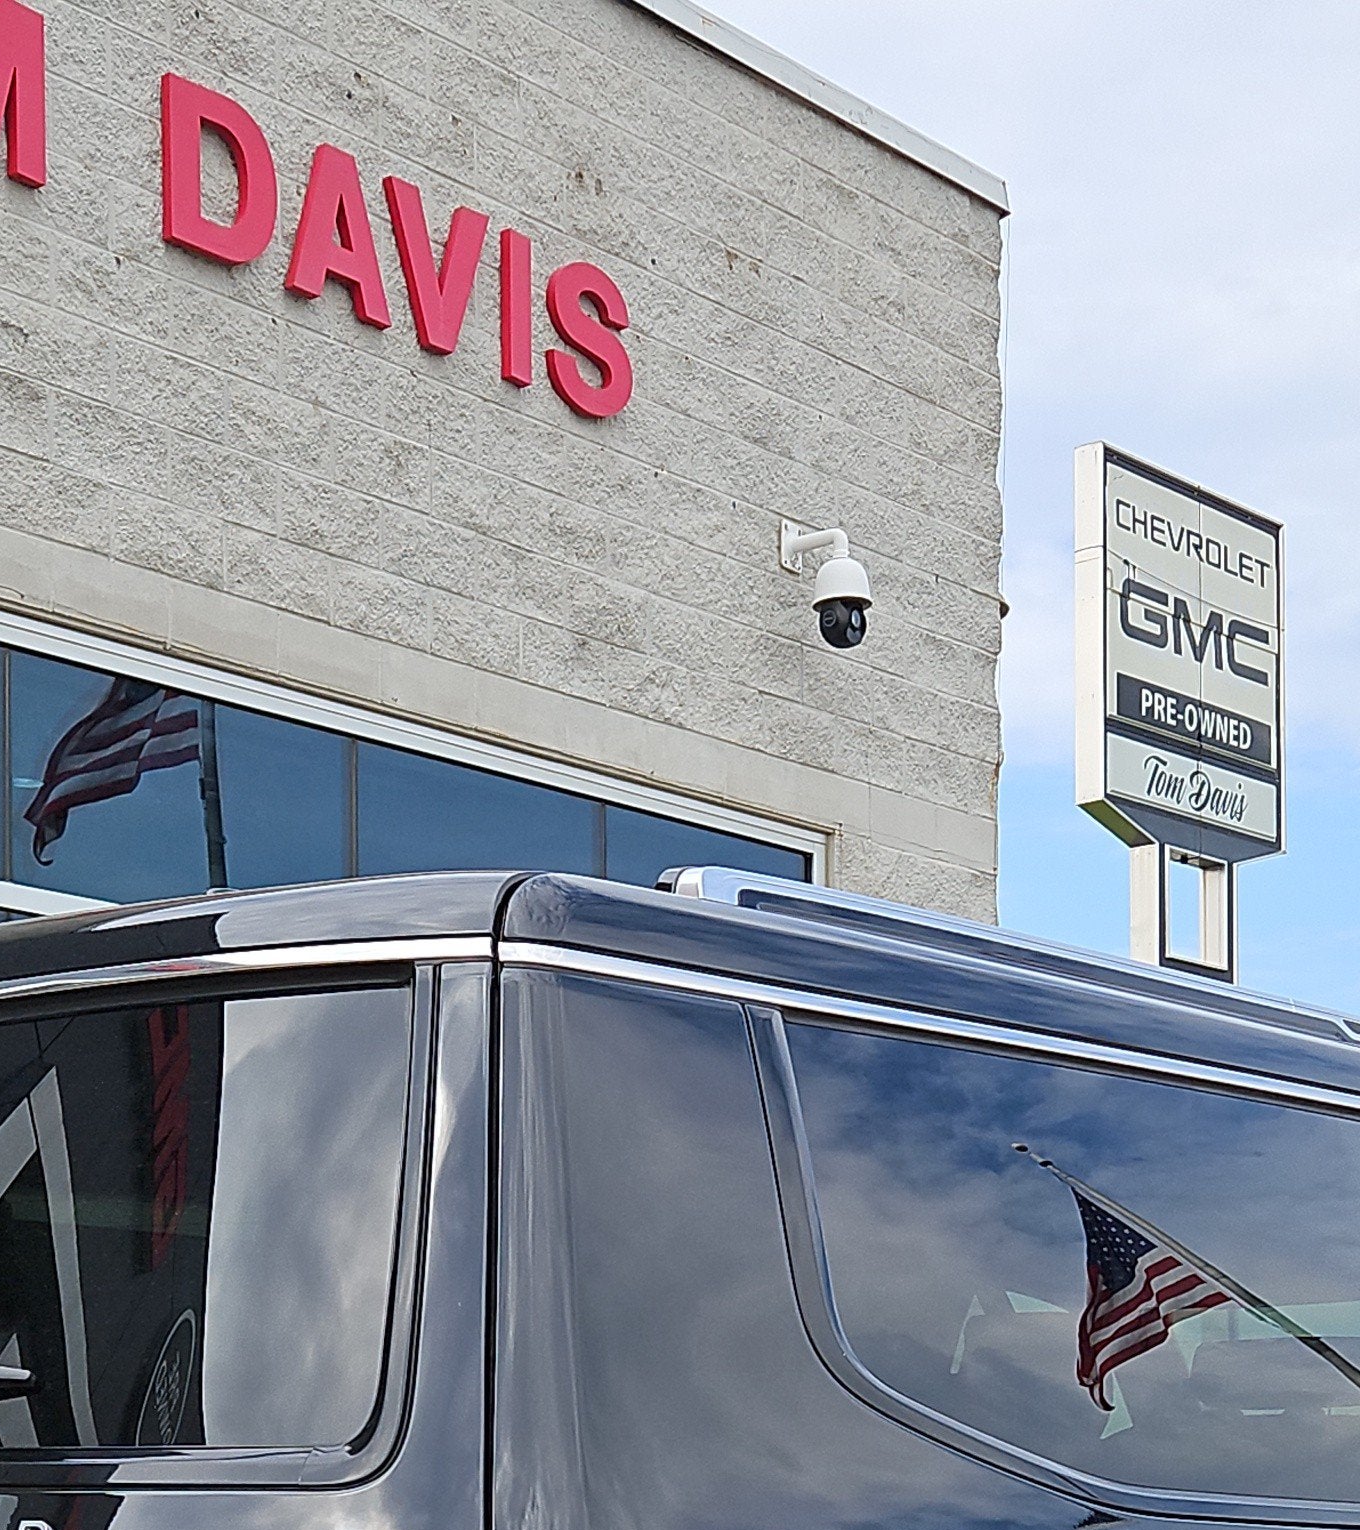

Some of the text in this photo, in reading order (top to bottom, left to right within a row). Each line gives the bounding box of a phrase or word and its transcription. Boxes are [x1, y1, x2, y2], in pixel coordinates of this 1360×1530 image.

[160, 72, 635, 419] DAVIS
[1114, 497, 1272, 589] CHEVROLET
[1119, 575, 1270, 688] GMC
[1140, 687, 1252, 751] PRE-OWNED
[1143, 754, 1249, 823] Tom Davis
